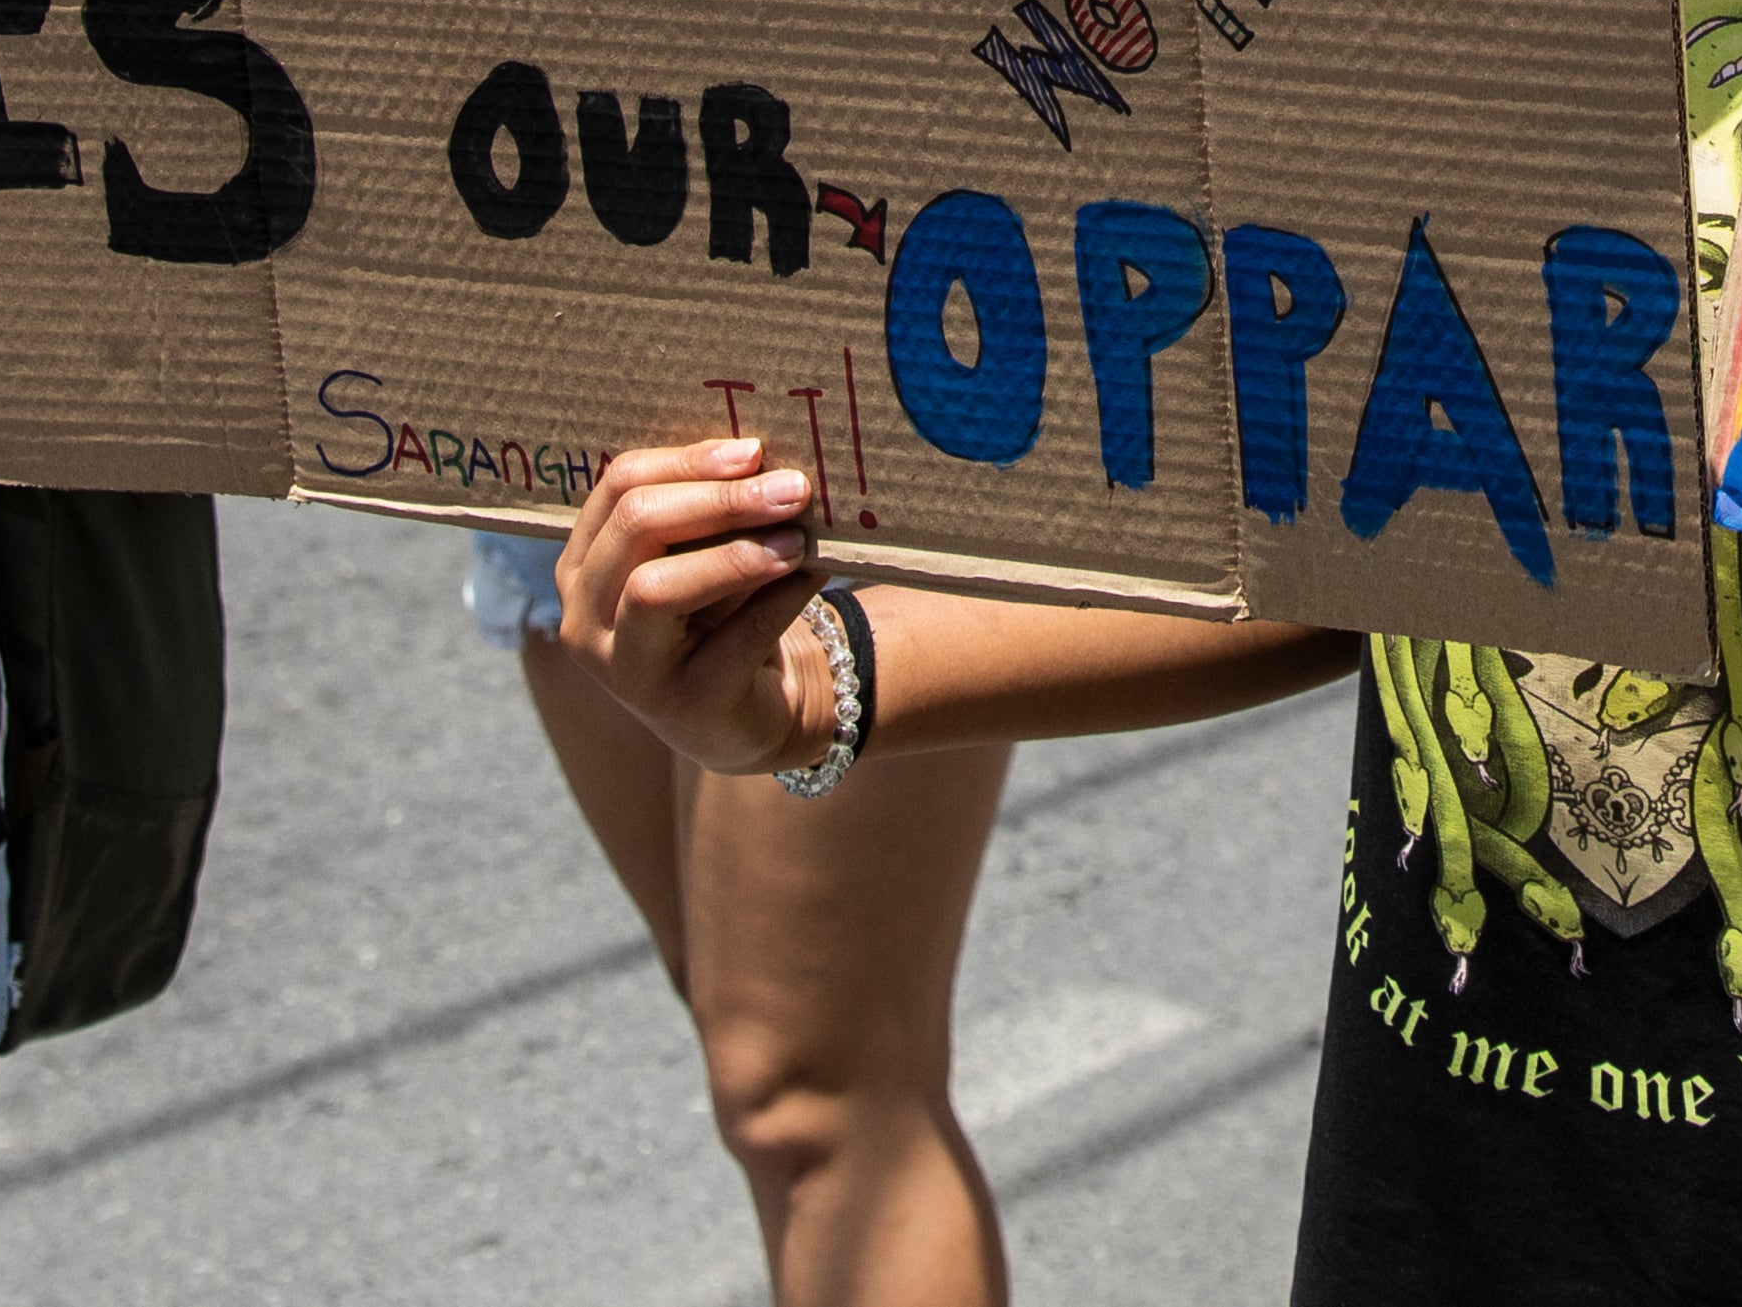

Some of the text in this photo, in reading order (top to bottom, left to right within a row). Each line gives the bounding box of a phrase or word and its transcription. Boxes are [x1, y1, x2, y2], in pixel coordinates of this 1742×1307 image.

[448, 61, 811, 276] OUR
[884, 189, 1681, 590] OPPAR
[1370, 975, 1429, 1047] at
[1447, 1031, 1559, 1098] me
[1591, 1061, 1716, 1127] one
